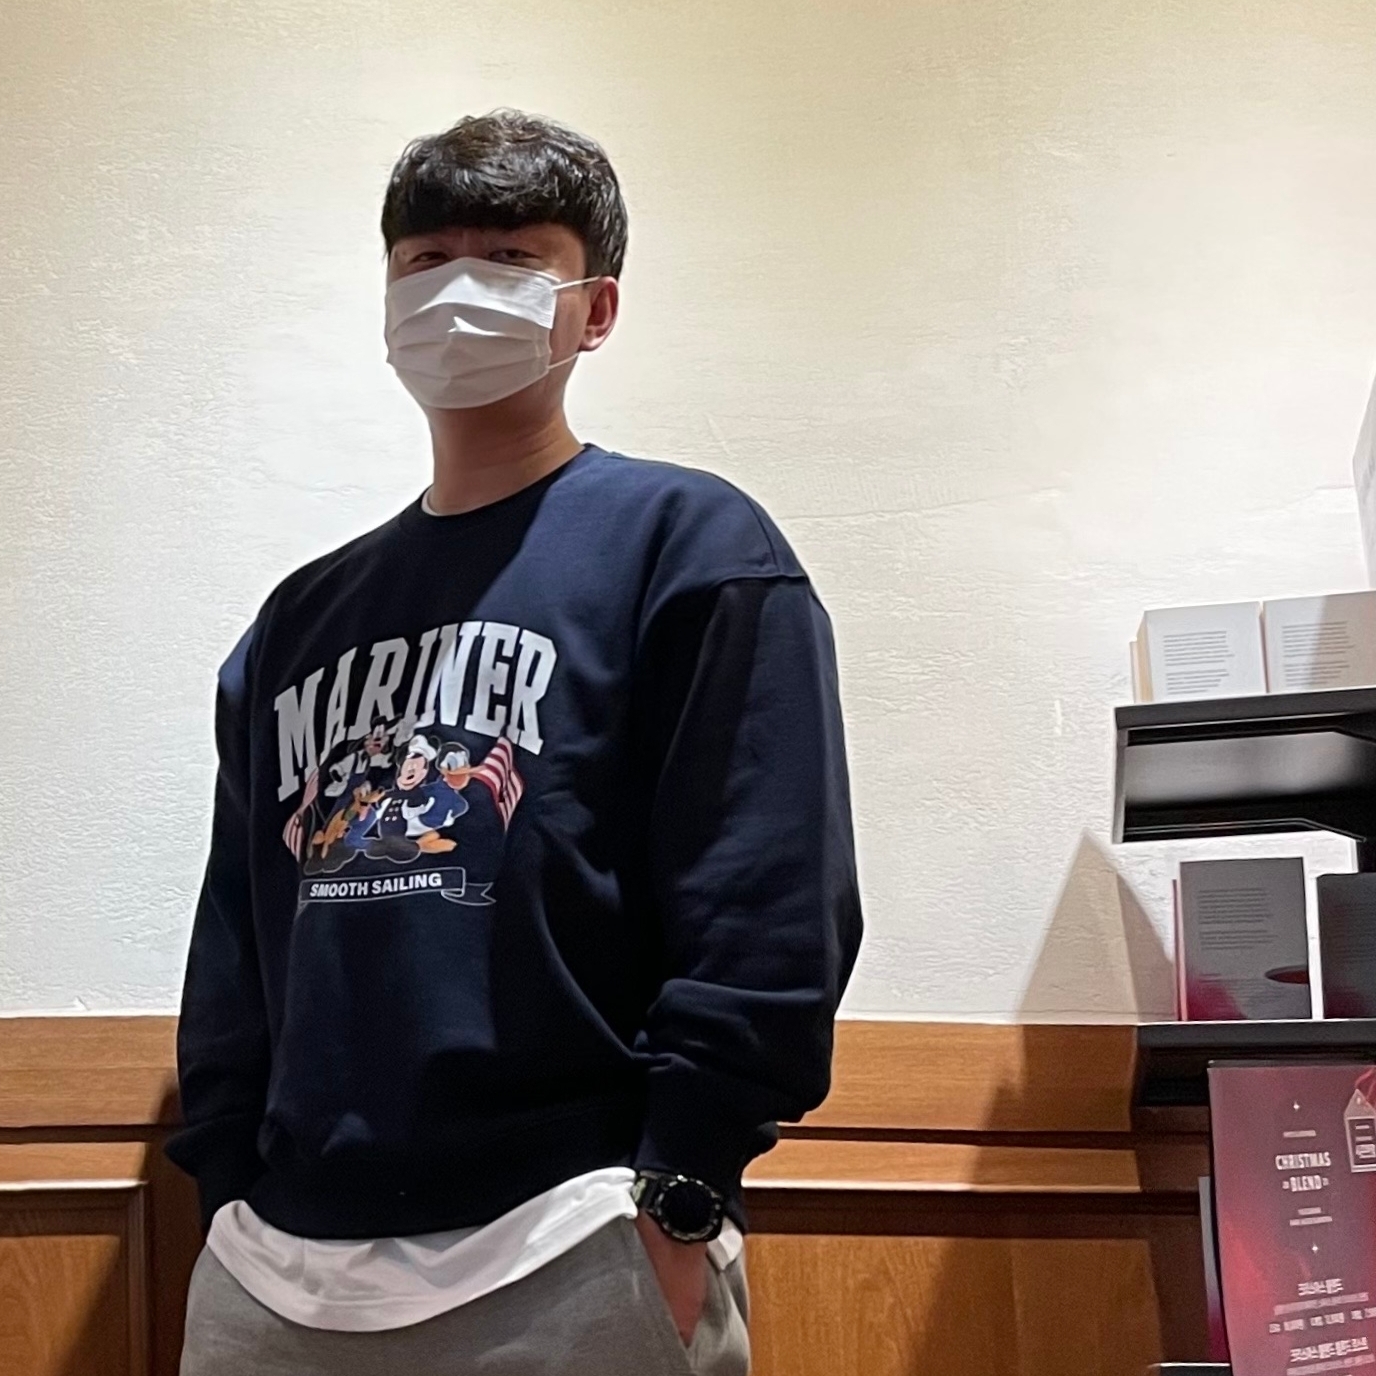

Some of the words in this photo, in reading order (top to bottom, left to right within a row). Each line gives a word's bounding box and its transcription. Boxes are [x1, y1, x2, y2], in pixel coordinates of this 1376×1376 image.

[274, 621, 557, 802] MARINER
[309, 882, 369, 897] SMOOTH
[371, 873, 443, 895] SAILING
